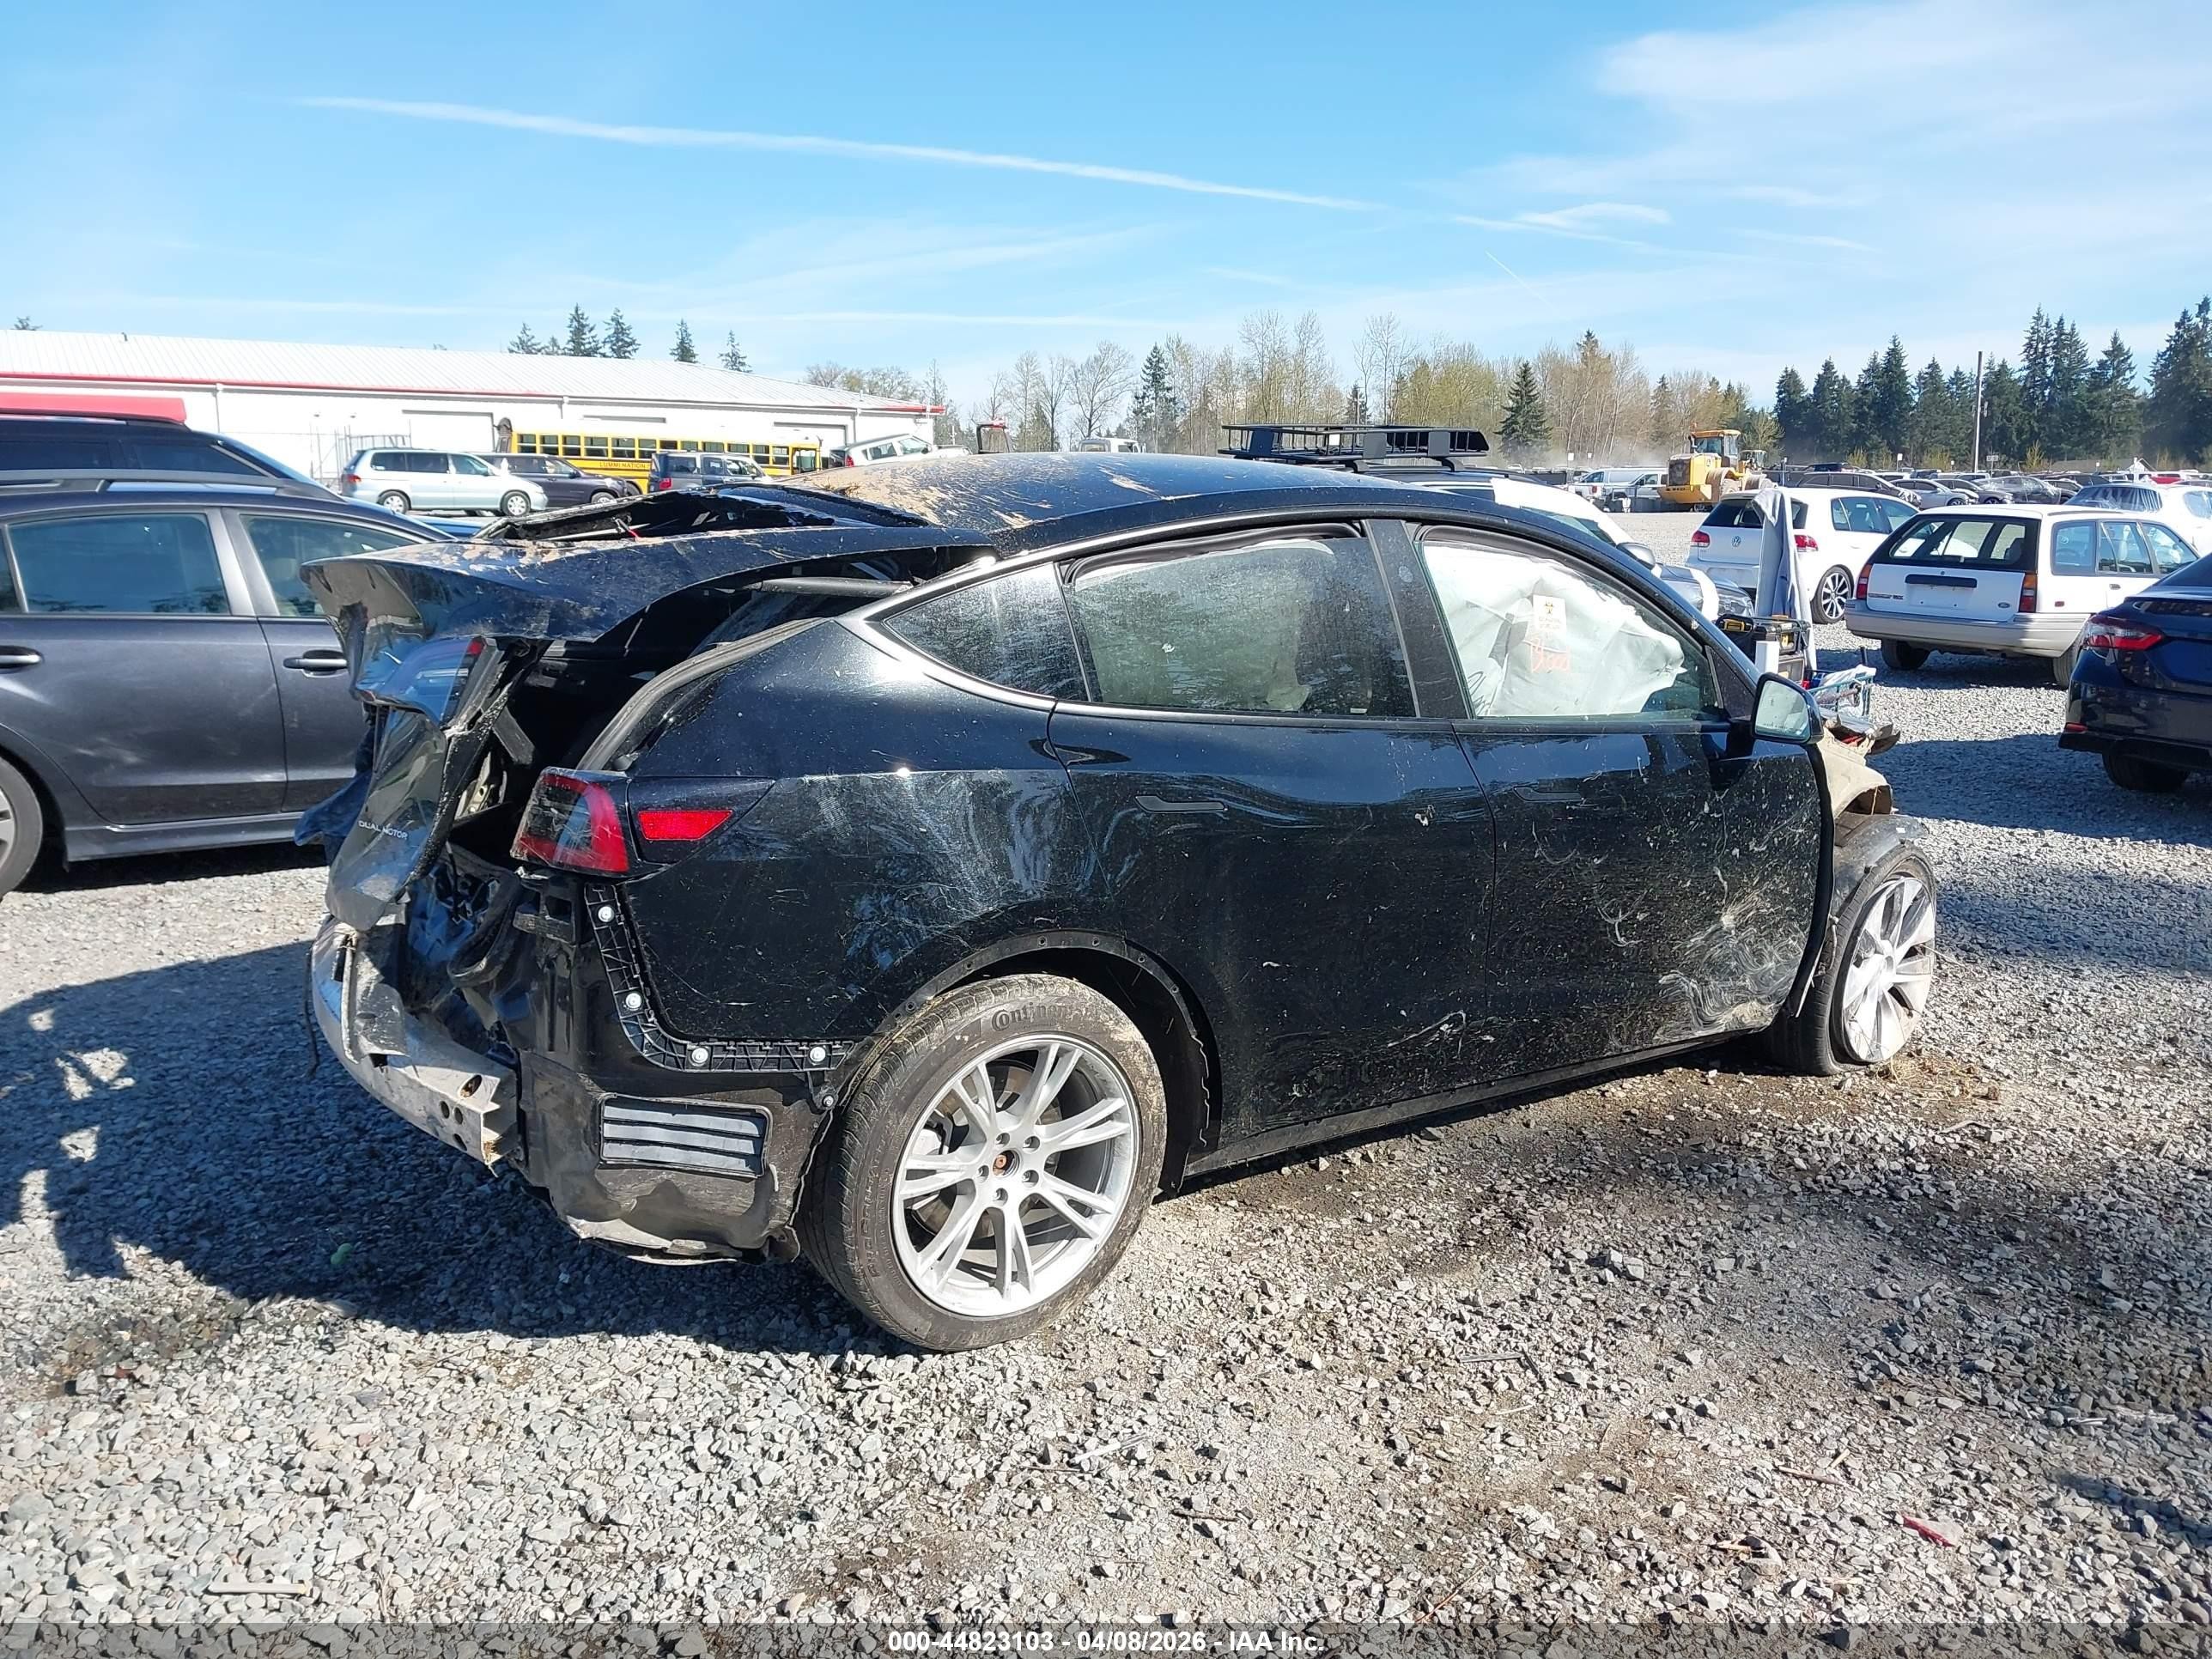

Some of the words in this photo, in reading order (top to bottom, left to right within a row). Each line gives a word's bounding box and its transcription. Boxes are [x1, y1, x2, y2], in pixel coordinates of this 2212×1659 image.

[358, 820, 381, 832] DUAL
[383, 825, 408, 840] MOTOR
[992, 1001, 1073, 1031] Continen
